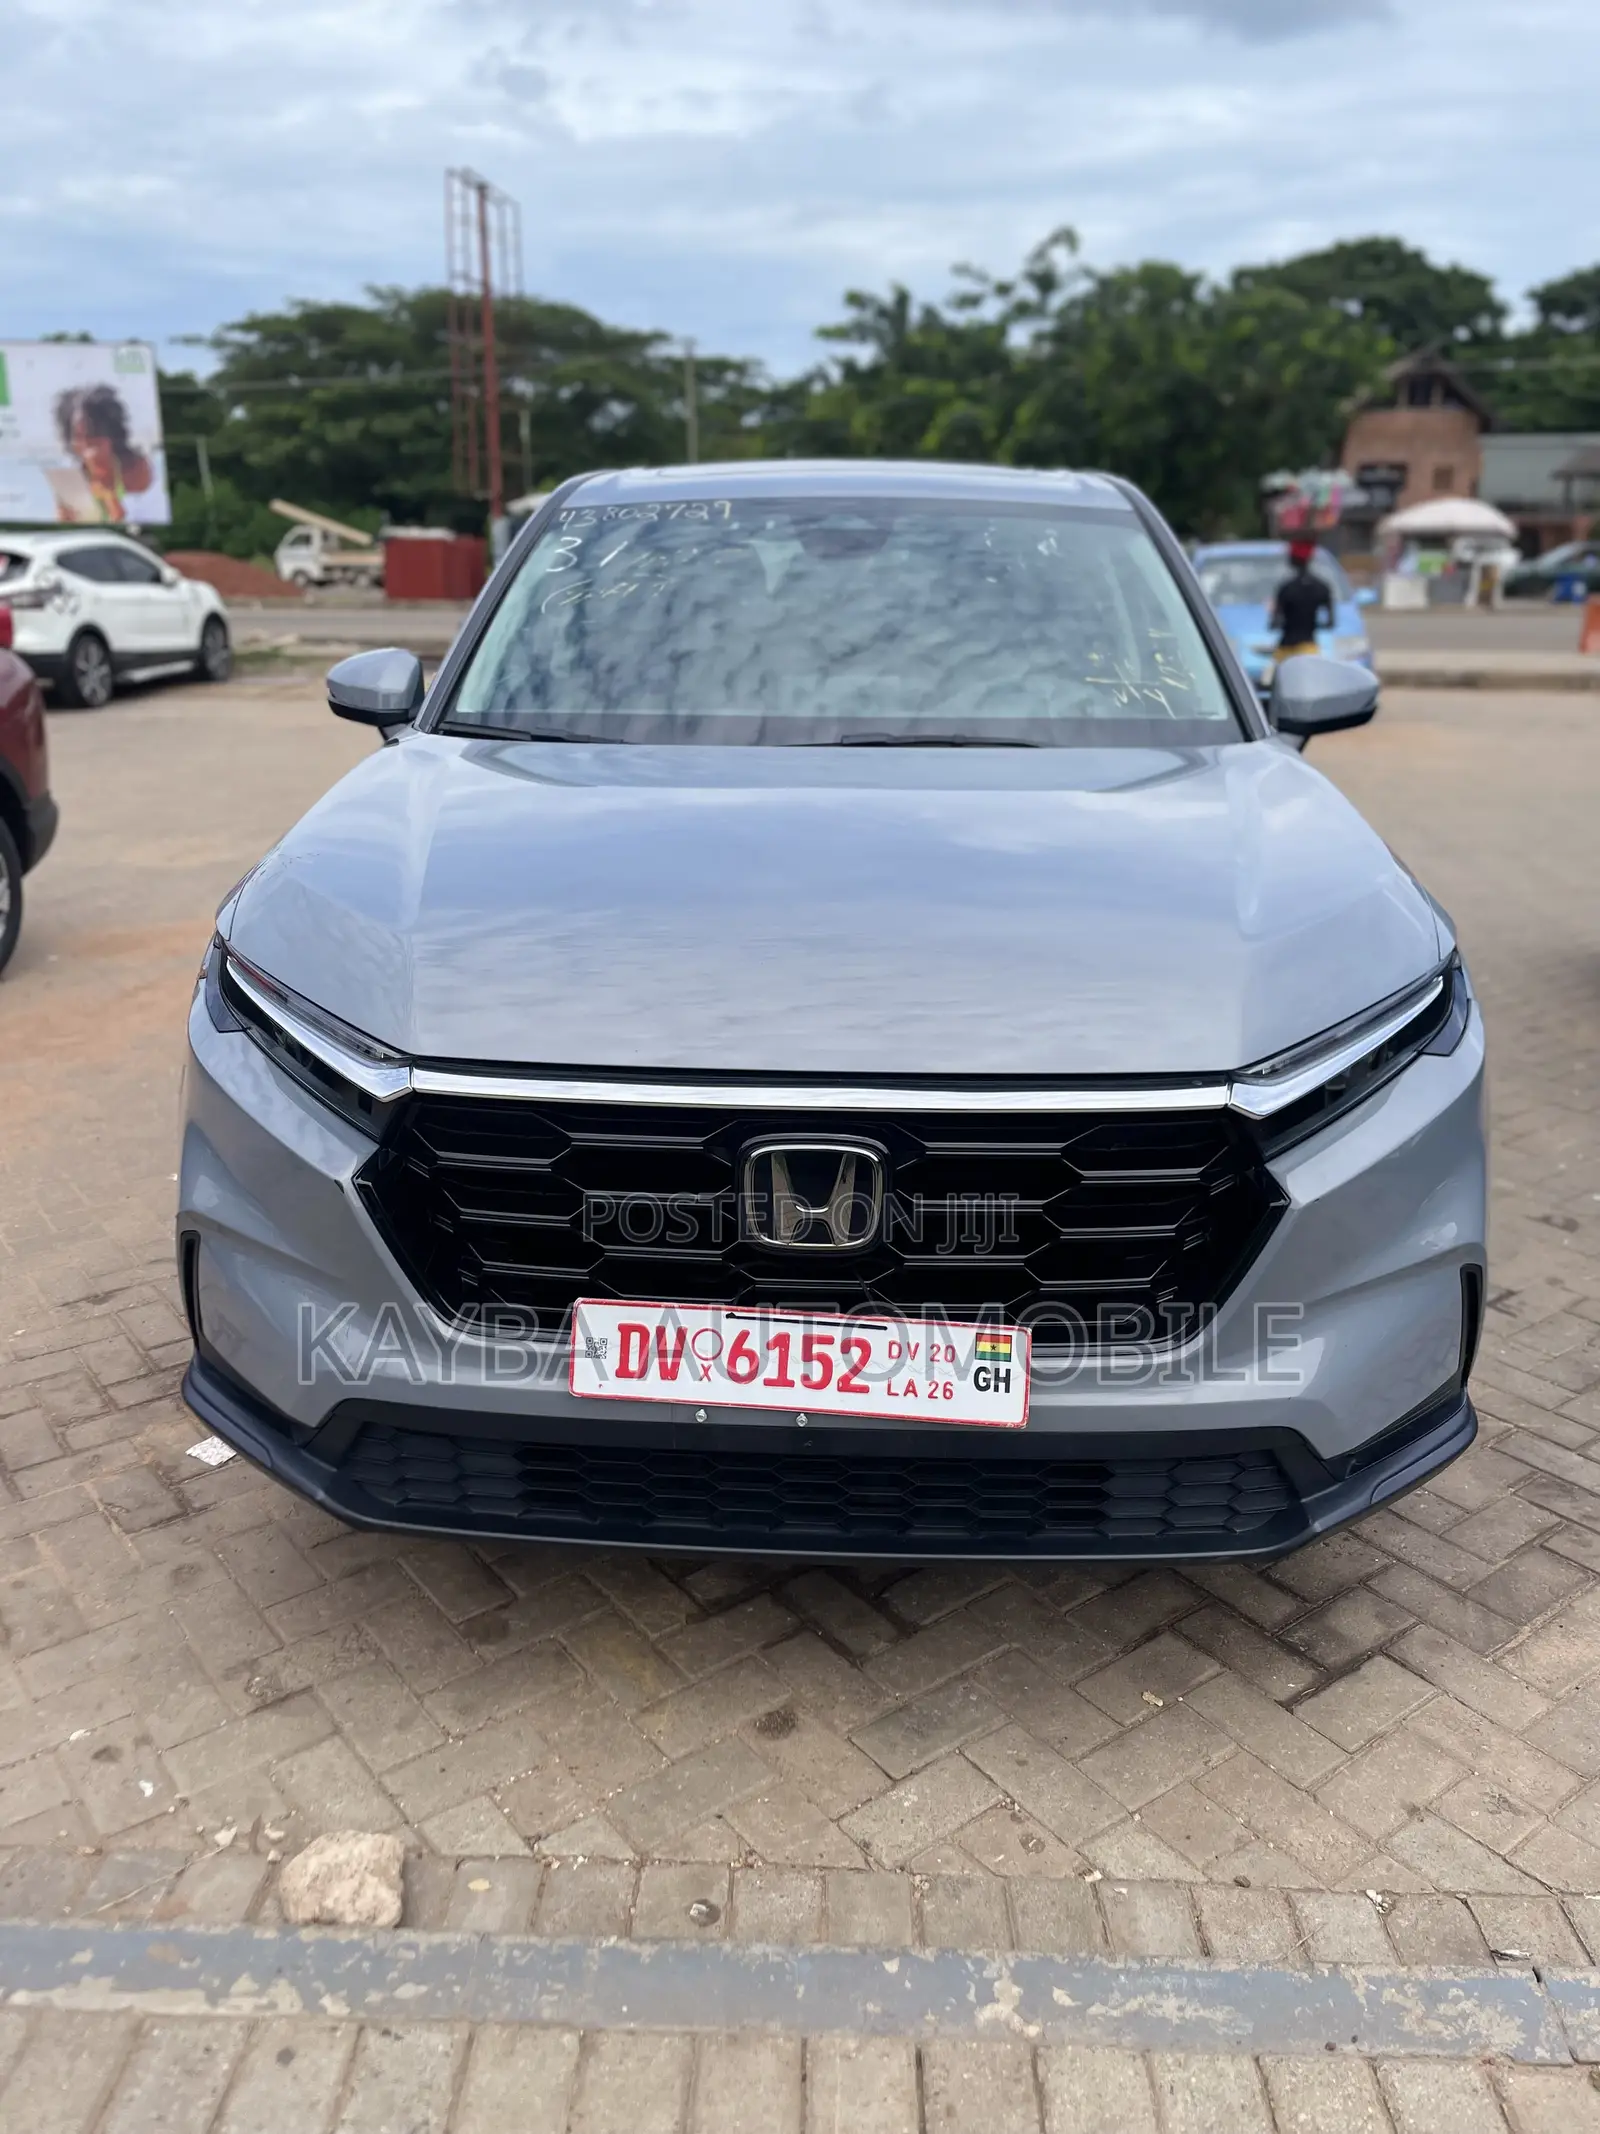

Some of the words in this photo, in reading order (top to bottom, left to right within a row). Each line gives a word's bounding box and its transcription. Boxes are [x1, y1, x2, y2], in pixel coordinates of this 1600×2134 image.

[615, 1323, 688, 1381] DV
[726, 1329, 872, 1393] 6152
[888, 1340, 920, 1360] DV
[929, 1343, 956, 1363] 20
[887, 1377, 918, 1397] LA
[927, 1381, 954, 1400] 26
[973, 1366, 1012, 1393] GH
